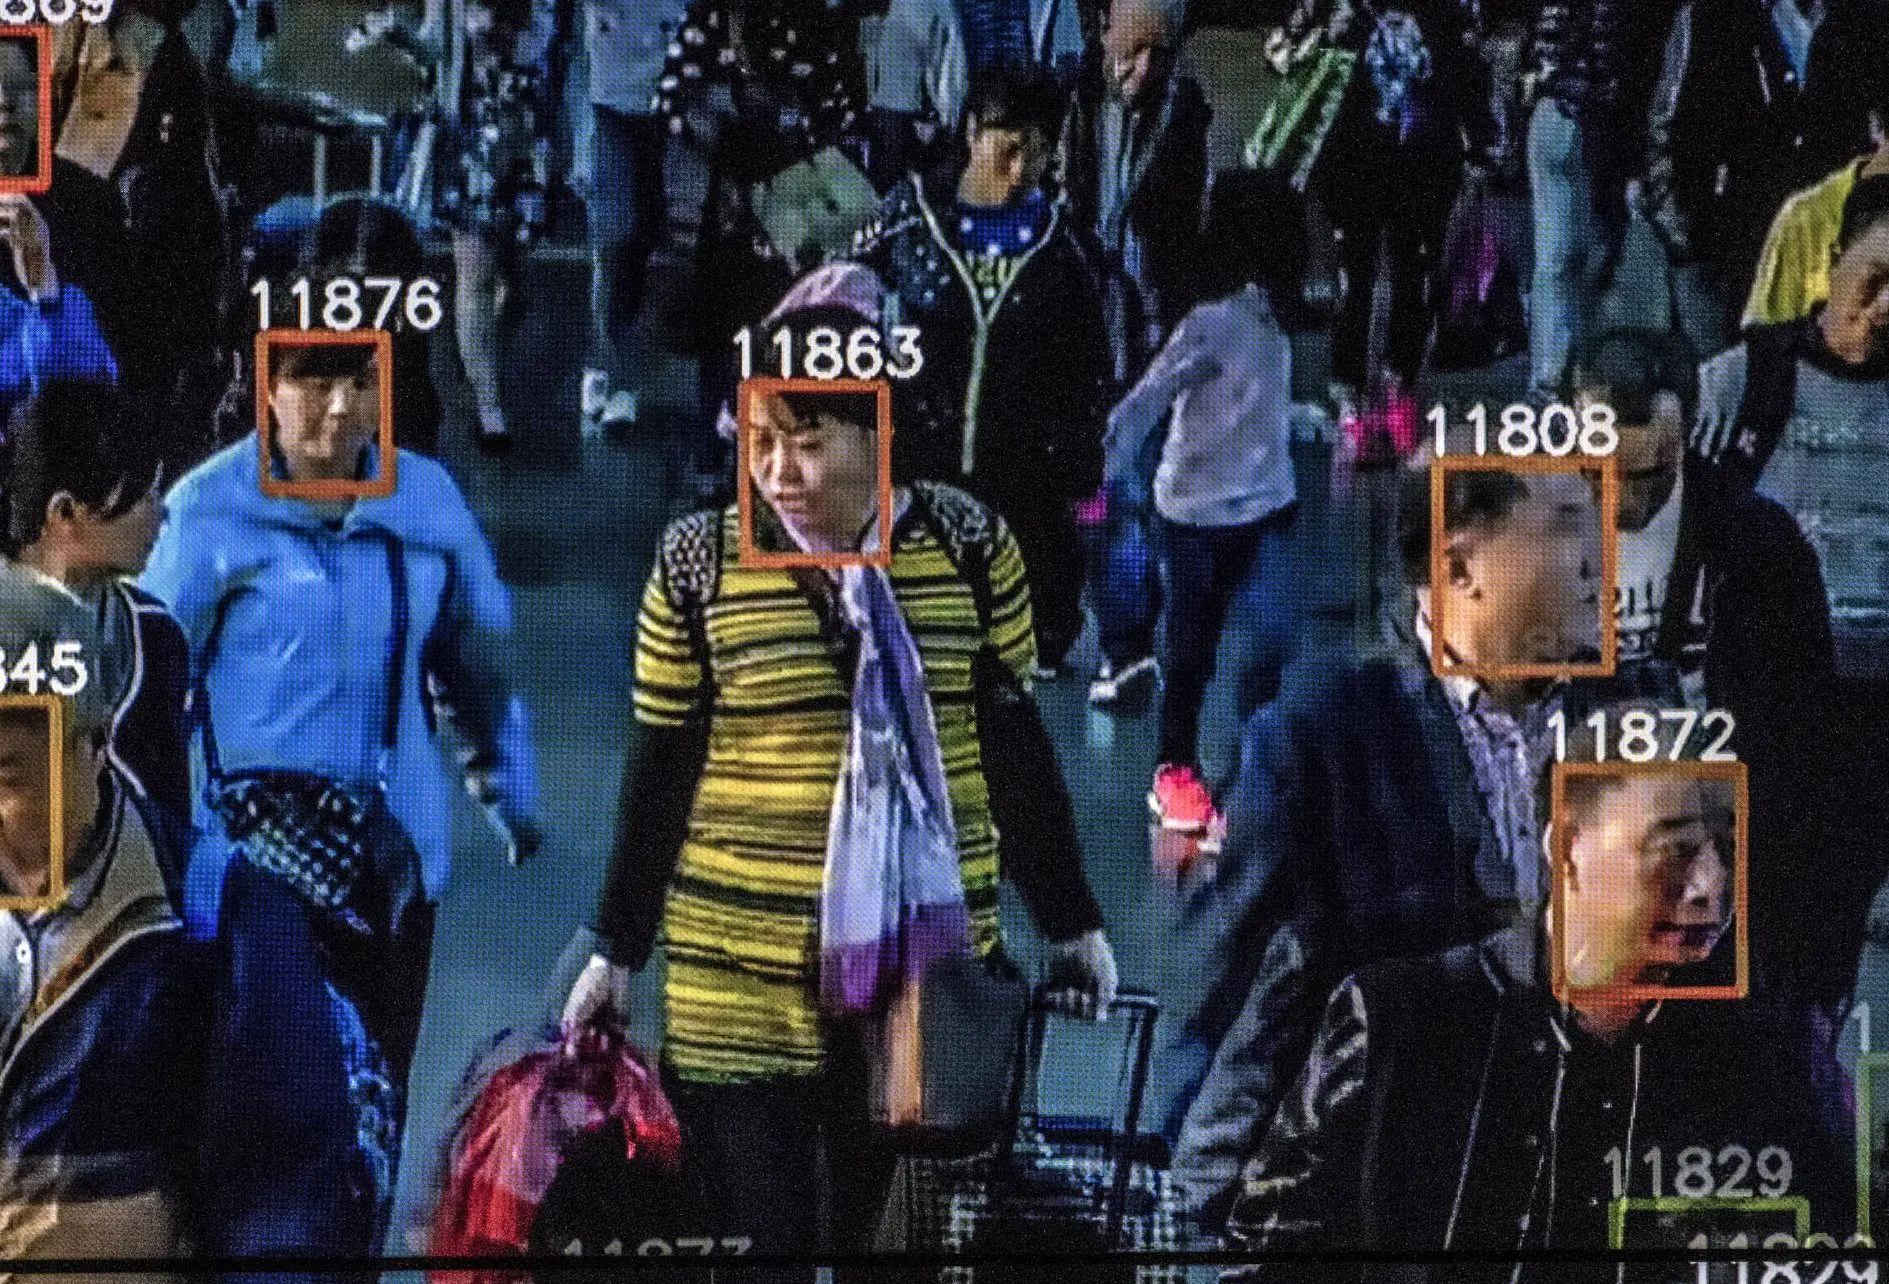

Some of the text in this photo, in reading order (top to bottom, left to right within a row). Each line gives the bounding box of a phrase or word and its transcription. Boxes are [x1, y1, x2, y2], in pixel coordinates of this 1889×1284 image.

[250, 278, 444, 331] 11876
[732, 327, 925, 380] 11863
[1426, 403, 1620, 457] 11808
[1547, 709, 1738, 762] 11872
[1603, 1146, 1794, 1199] 11829
